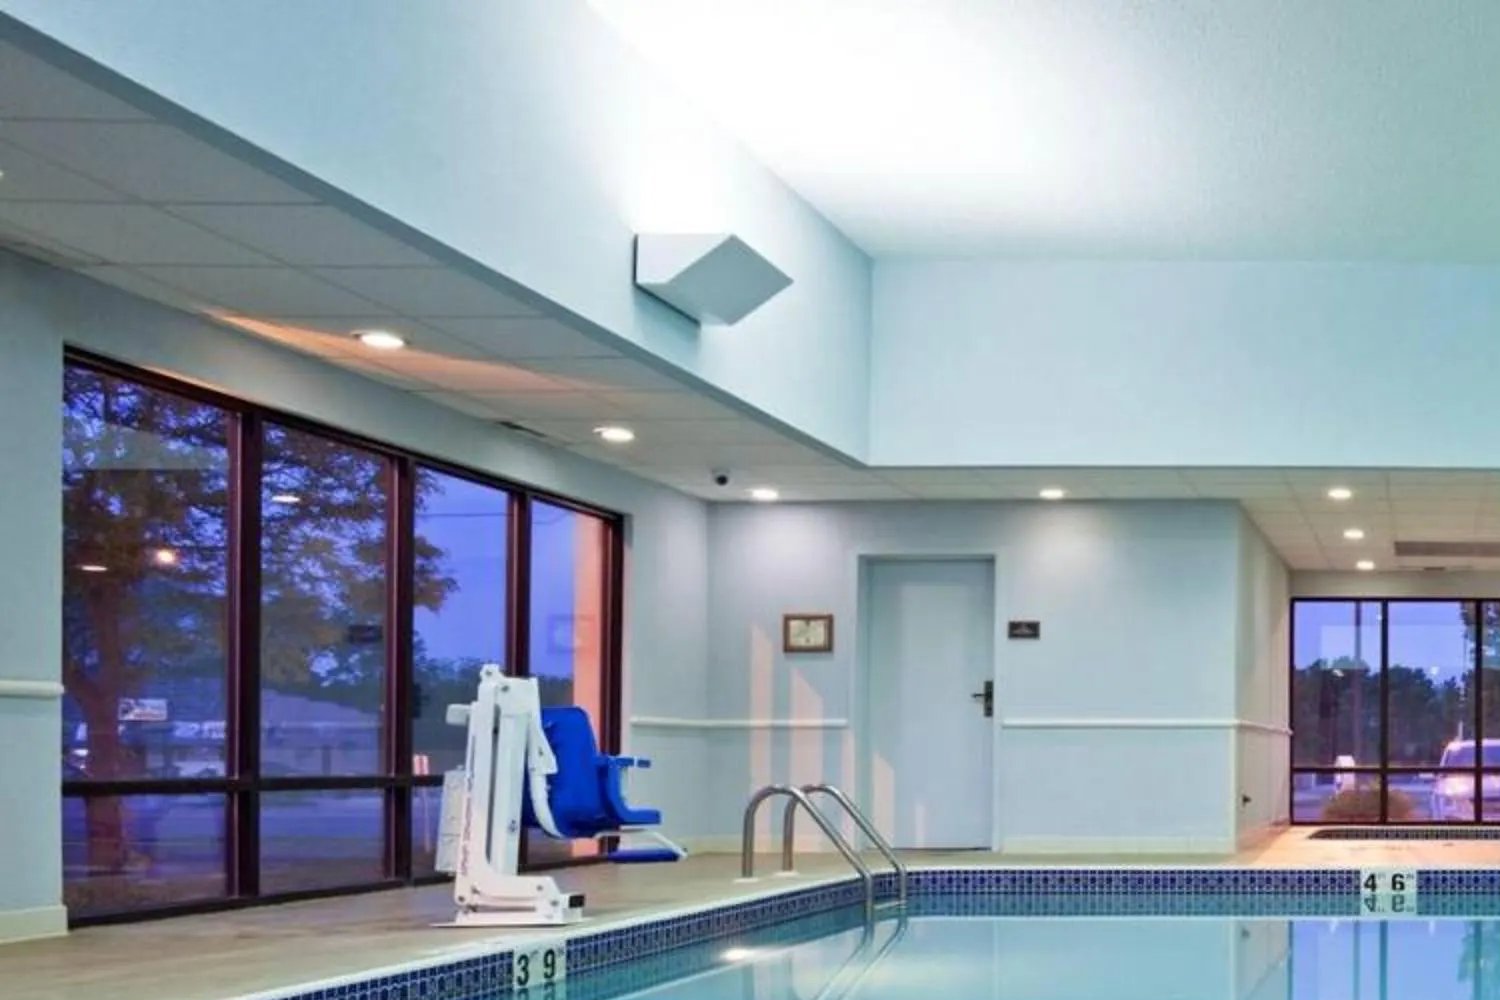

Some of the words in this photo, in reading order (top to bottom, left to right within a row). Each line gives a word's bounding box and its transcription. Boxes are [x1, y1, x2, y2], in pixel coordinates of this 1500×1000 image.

[1363, 873, 1376, 892] 4
[1391, 873, 1405, 891] 6
[517, 953, 529, 987] 3
[543, 948, 556, 979] 9
